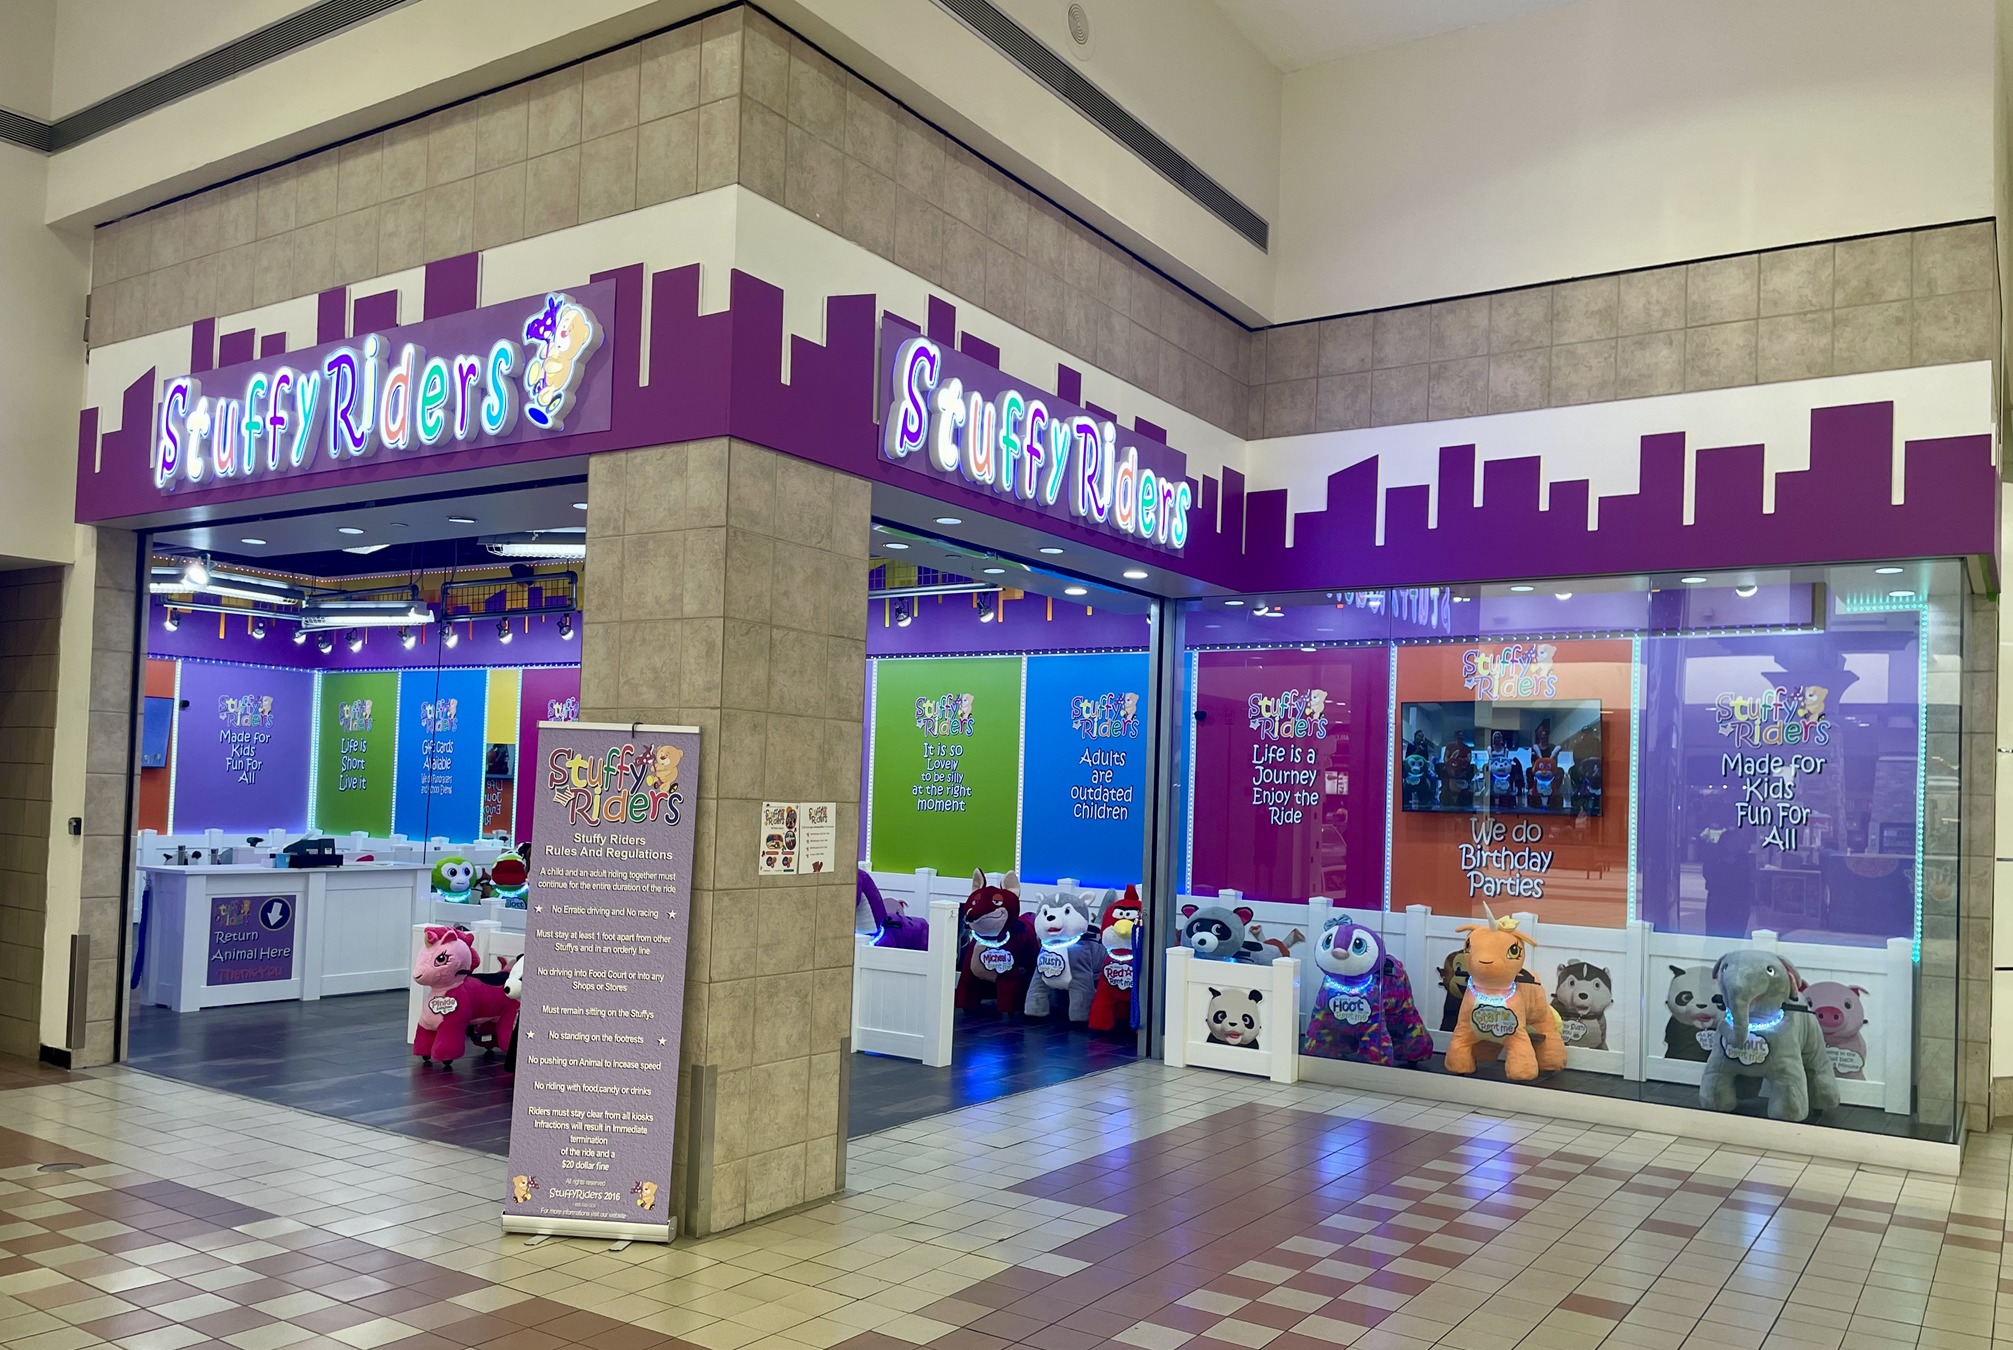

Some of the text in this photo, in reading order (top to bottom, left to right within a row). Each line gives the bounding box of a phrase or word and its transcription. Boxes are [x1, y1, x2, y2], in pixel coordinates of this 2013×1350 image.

[1463, 645, 1533, 677] Stuffy
[1474, 673, 1558, 701] Riders
[915, 693, 960, 720] Stuffy
[1071, 692, 1121, 721] Stuffy
[1248, 689, 1306, 720] Stuffy
[1715, 686, 1799, 723] Stuffy
[923, 717, 975, 738] Riders
[1081, 718, 1140, 740] Riders
[1257, 716, 1329, 741] Riders
[1732, 719, 1831, 748] Riders
[220, 730, 270, 745] Made for
[231, 744, 256, 758] Kids
[340, 738, 358, 753] Life
[924, 742, 963, 758] It is so
[1079, 748, 1127, 767] Adults
[1252, 744, 1316, 765] Life is a
[226, 757, 263, 772] Fun For
[341, 756, 365, 772] Short
[548, 743, 649, 794] Stuffy
[927, 758, 959, 771] Lovely
[1722, 752, 1828, 777] Made for
[238, 771, 256, 785] All
[338, 775, 358, 792] Live
[921, 772, 963, 783] to be silly
[1091, 770, 1113, 784] are
[1252, 766, 1317, 787] Journey
[912, 784, 972, 798] at the right
[1071, 785, 1133, 802] outdated
[1252, 787, 1319, 806] Enjoy the
[1745, 777, 1796, 802] Kids
[569, 786, 684, 827] Riders
[917, 798, 966, 812] moment
[1269, 807, 1303, 825] Ride
[1735, 802, 1811, 827] Fun For
[1469, 817, 1542, 845] We do
[1762, 825, 1797, 851] All
[574, 833, 646, 846] Stuffy Riders
[546, 845, 673, 860] Rules And Regulations
[1458, 843, 1554, 873] Birthday
[547, 868, 564, 876] child
[608, 870, 628, 880] riding
[629, 871, 656, 880] together
[658, 872, 676, 880] must
[538, 880, 567, 888] continue
[580, 881, 590, 889] the
[592, 882, 610, 890] entire
[612, 882, 640, 891] duration
[650, 884, 661, 892] the
[663, 885, 676, 893] ride
[1466, 870, 1545, 898] Parties
[552, 905, 658, 919] No Erratic driving and No racing
[214, 931, 259, 944] Return
[536, 930, 554, 938] Must
[555, 930, 569, 940] stay
[579, 931, 594, 939] least
[602, 932, 615, 940] foot
[617, 934, 634, 942] apart
[636, 934, 651, 942] from
[211, 946, 291, 962] Animal Here
[554, 942, 578, 953] Stuffys
[580, 944, 593, 952] and
[613, 946, 636, 955] orderly
[538, 967, 664, 982] No driving Food Court any
[1105, 968, 1124, 978] Red
[573, 981, 627, 991] Shops Stores
[542, 1005, 560, 1014] Must
[561, 1006, 583, 1015] remain
[586, 1007, 605, 1017] sitting
[618, 1009, 628, 1017] the
[630, 1010, 654, 1019] Stuffys
[549, 1031, 559, 1039] No
[561, 1032, 589, 1042] standing
[615, 1034, 644, 1043] footrests
[529, 1056, 538, 1064] No
[540, 1057, 567, 1067] pushing
[579, 1058, 602, 1067] Animal
[640, 1062, 661, 1070] speed
[534, 1081, 544, 1090] No
[546, 1082, 565, 1092] riding
[566, 1083, 581, 1092] with
[631, 1086, 651, 1095] drinks
[529, 1107, 653, 1121] Riders must stay clear from kiosks
[534, 1120, 603, 1131] Infractions will result
[570, 1135, 608, 1144] termination
[570, 1148, 610, 1158] the ride and
[562, 1160, 609, 1171] $20 dollar fine
[604, 1192, 620, 1201] 2016
